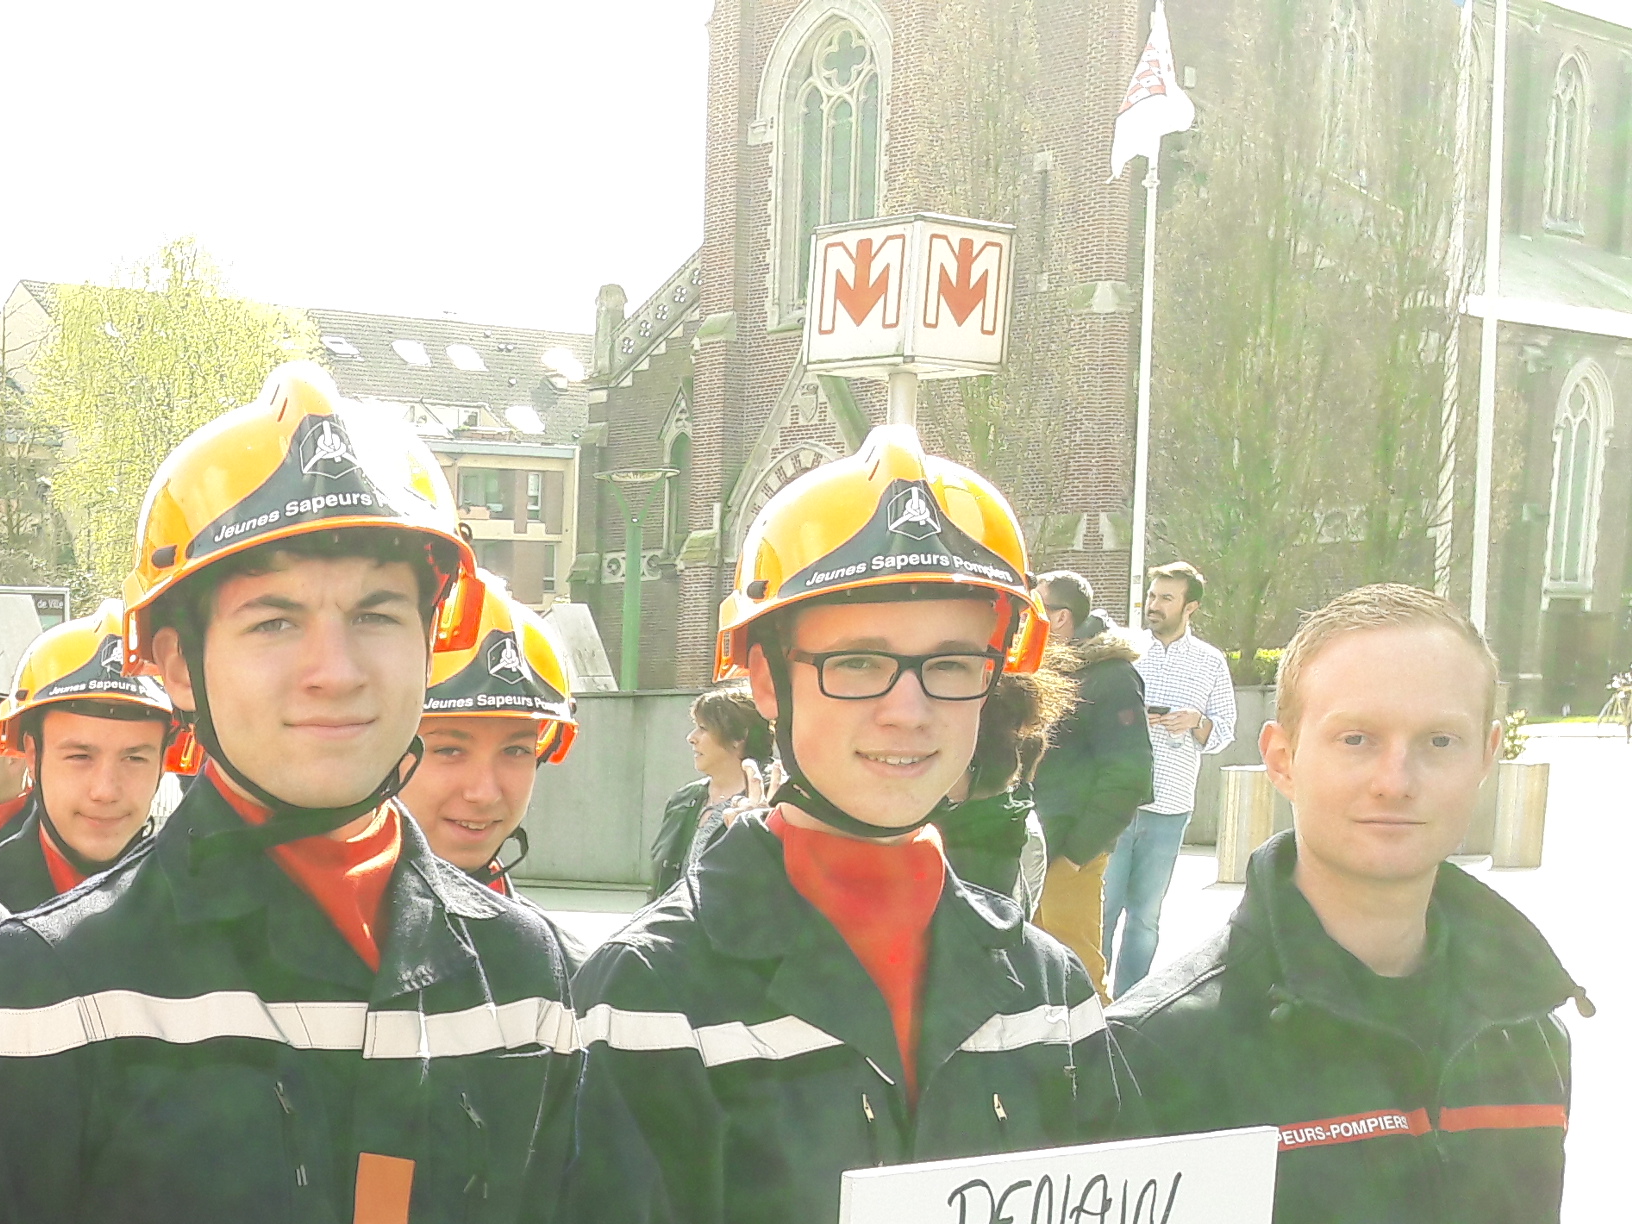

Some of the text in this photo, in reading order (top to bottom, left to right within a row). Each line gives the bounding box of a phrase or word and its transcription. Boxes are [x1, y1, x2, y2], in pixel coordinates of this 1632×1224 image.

[214, 492, 372, 542] Jeunes Sapeurs
[805, 553, 1013, 586] Jeunes Sapeurs Pompiers
[49, 679, 137, 696] Jeunes Sapeurs
[423, 697, 473, 709] Jeunes
[477, 694, 533, 708] Sapeurs
